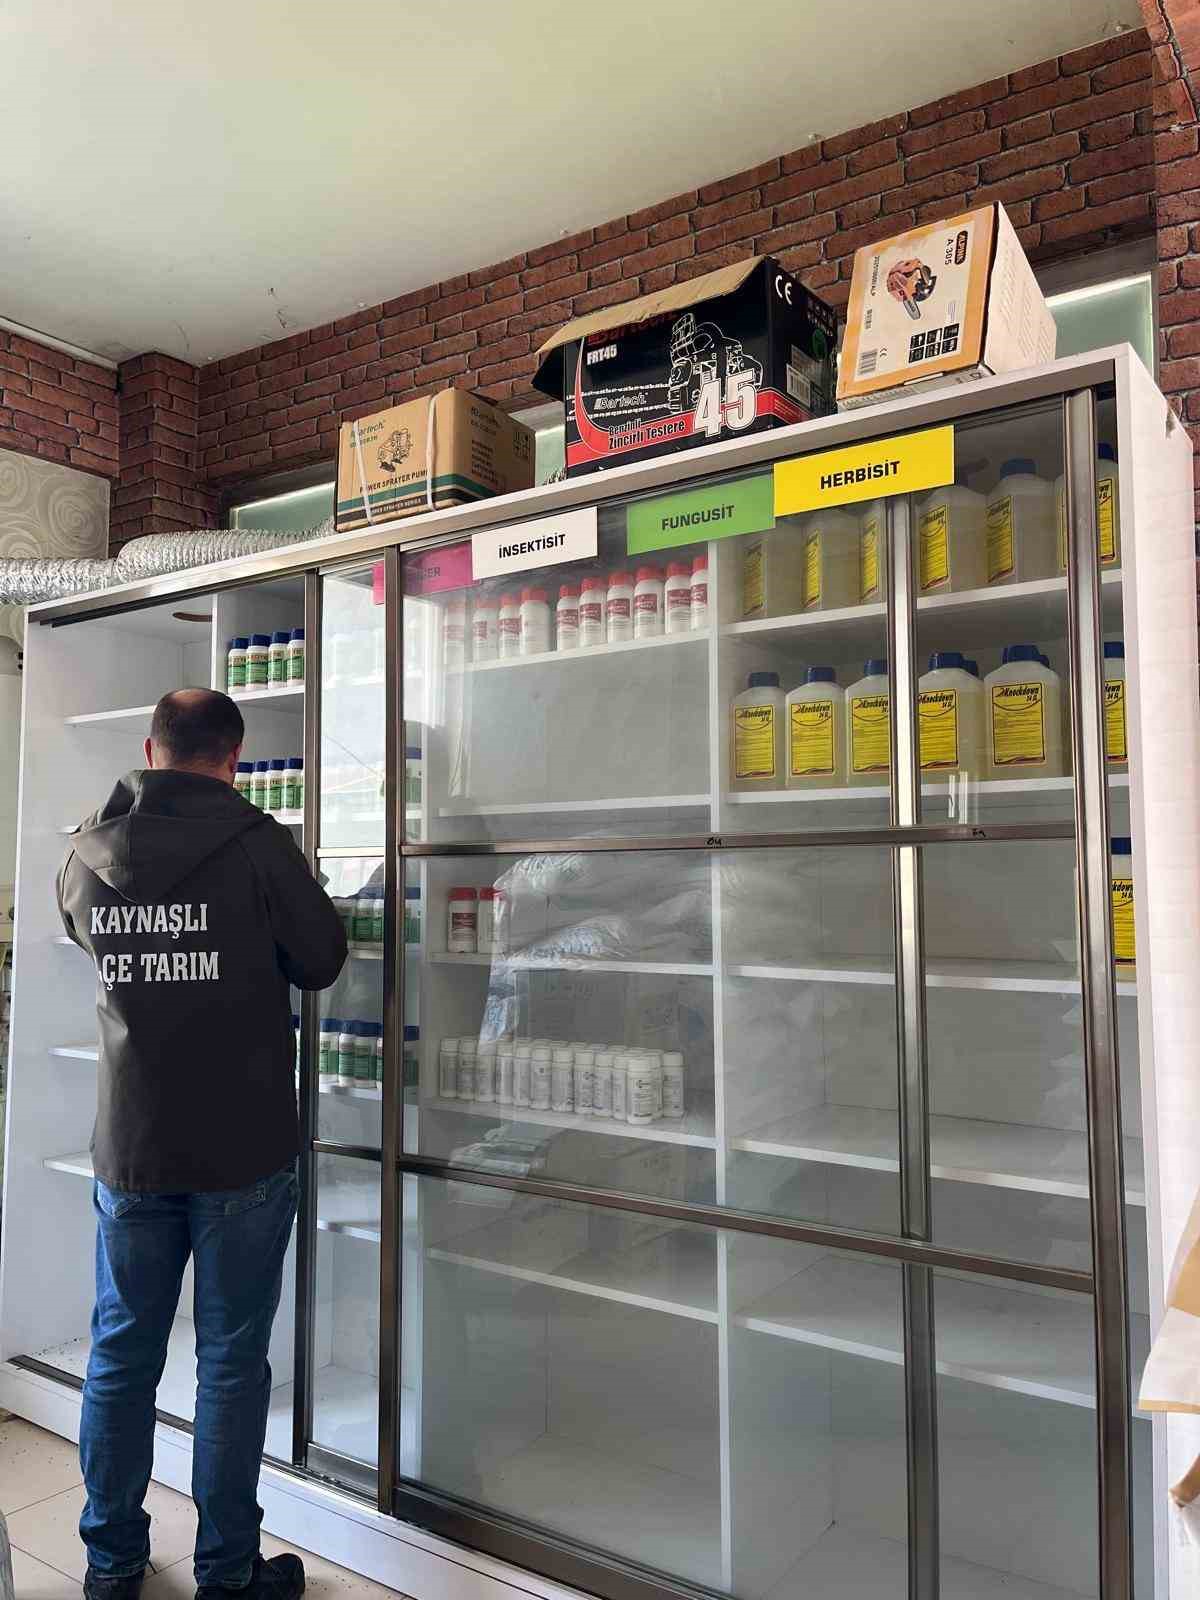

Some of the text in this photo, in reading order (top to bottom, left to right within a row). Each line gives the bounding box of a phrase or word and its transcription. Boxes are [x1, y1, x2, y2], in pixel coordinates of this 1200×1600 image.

[586, 343, 618, 366] FRT45
[693, 367, 757, 438] 45
[608, 420, 685, 450] Zincirli Testere
[820, 460, 900, 490] HERBİSİT
[661, 504, 735, 531] FUNGUSİT
[498, 533, 566, 559] İNSEKTİSİT
[90, 903, 208, 939] KAYNAŞLI
[140, 951, 219, 982] TARIM
